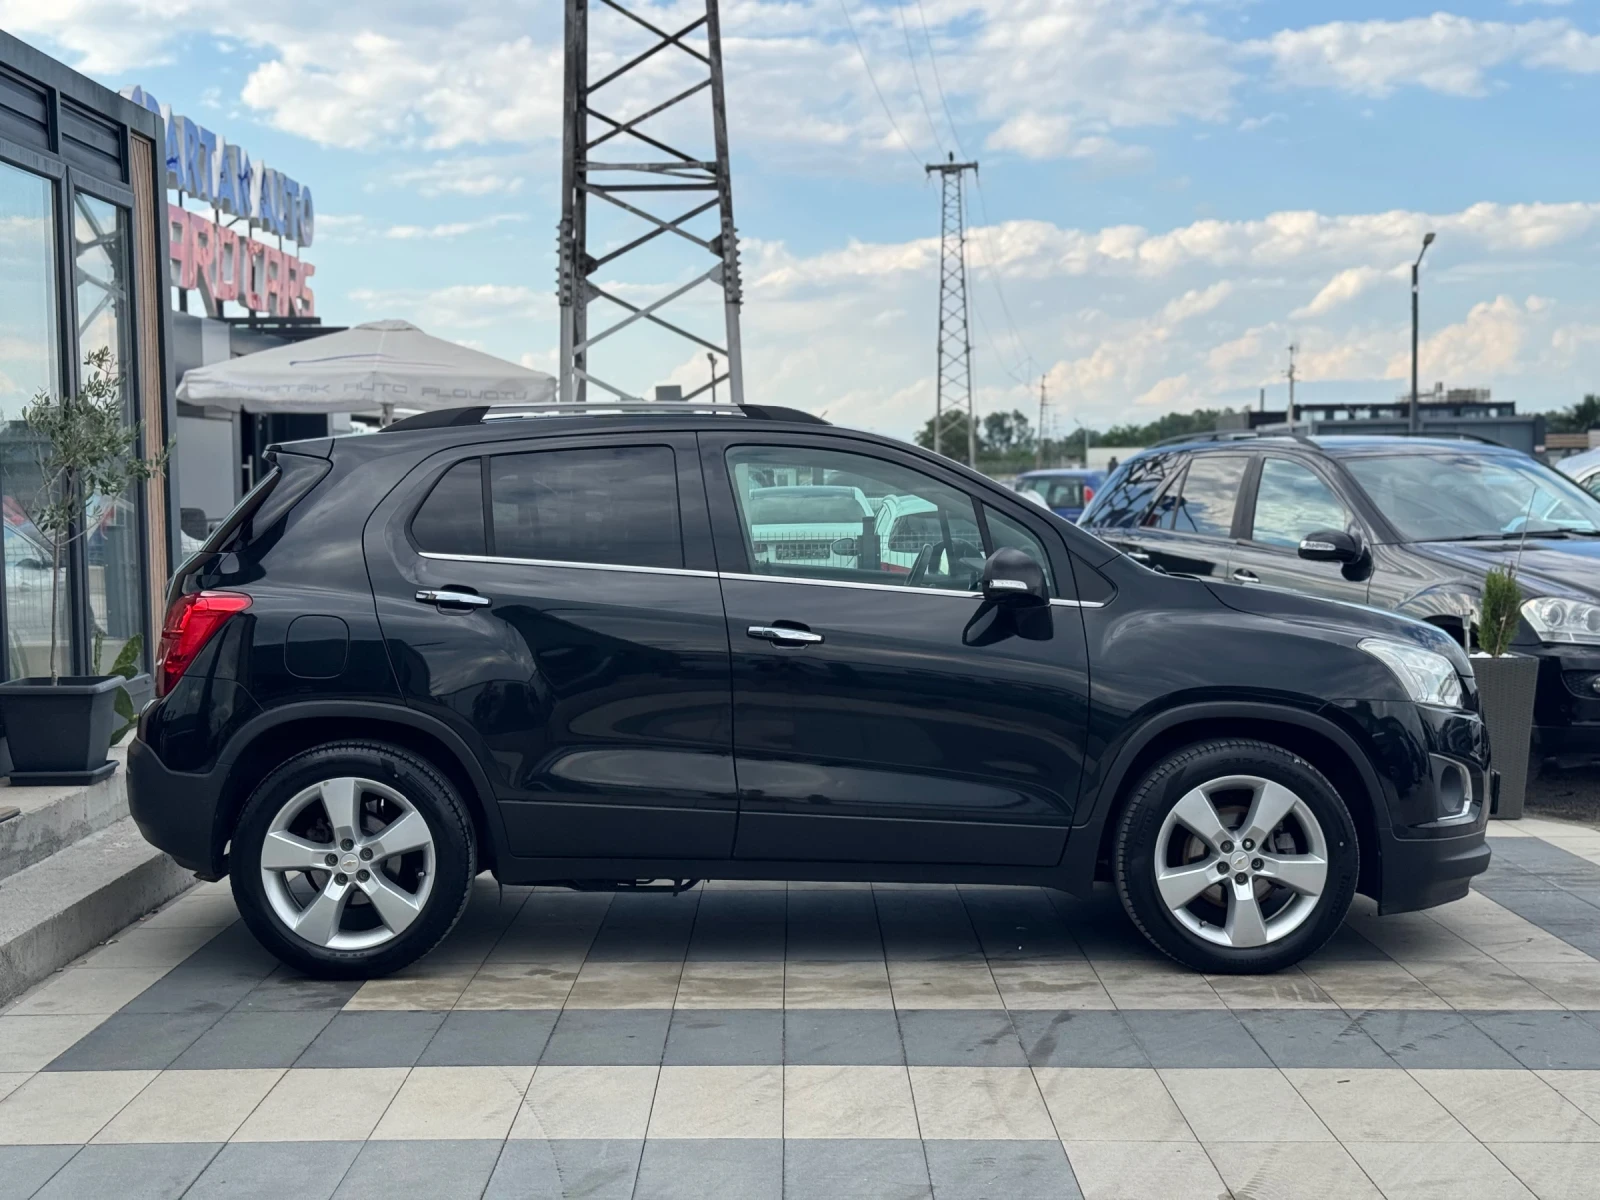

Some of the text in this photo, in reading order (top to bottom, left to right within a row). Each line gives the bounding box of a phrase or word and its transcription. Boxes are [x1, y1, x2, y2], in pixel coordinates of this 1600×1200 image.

[119, 84, 314, 247] ARTAK AUTO
[240, 236, 315, 318] CARS
[343, 381, 408, 394] AUTO
